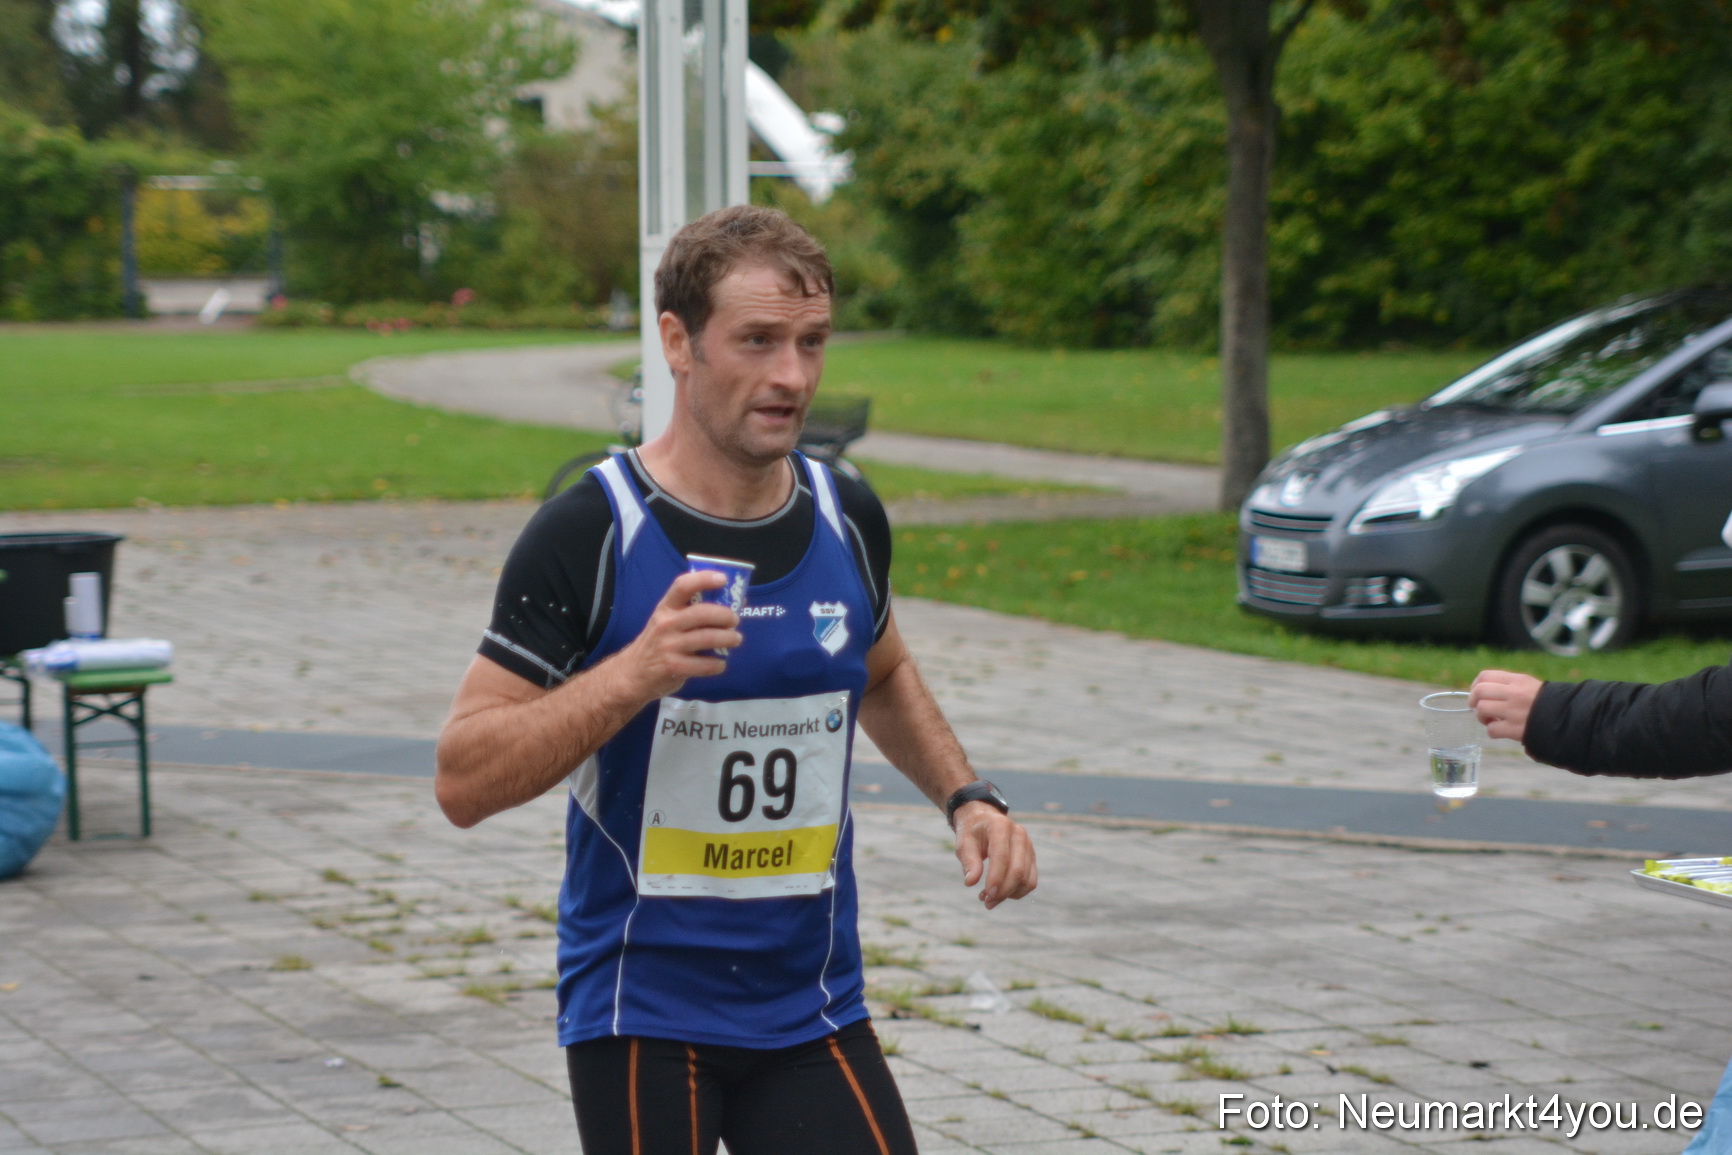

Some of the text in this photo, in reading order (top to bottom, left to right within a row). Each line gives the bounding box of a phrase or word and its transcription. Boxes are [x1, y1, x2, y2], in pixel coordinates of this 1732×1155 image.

[660, 716, 820, 740] PARTL Neumarkt
[717, 748, 798, 823] 69
[652, 812, 661, 825] A
[703, 839, 794, 871] Marcel
